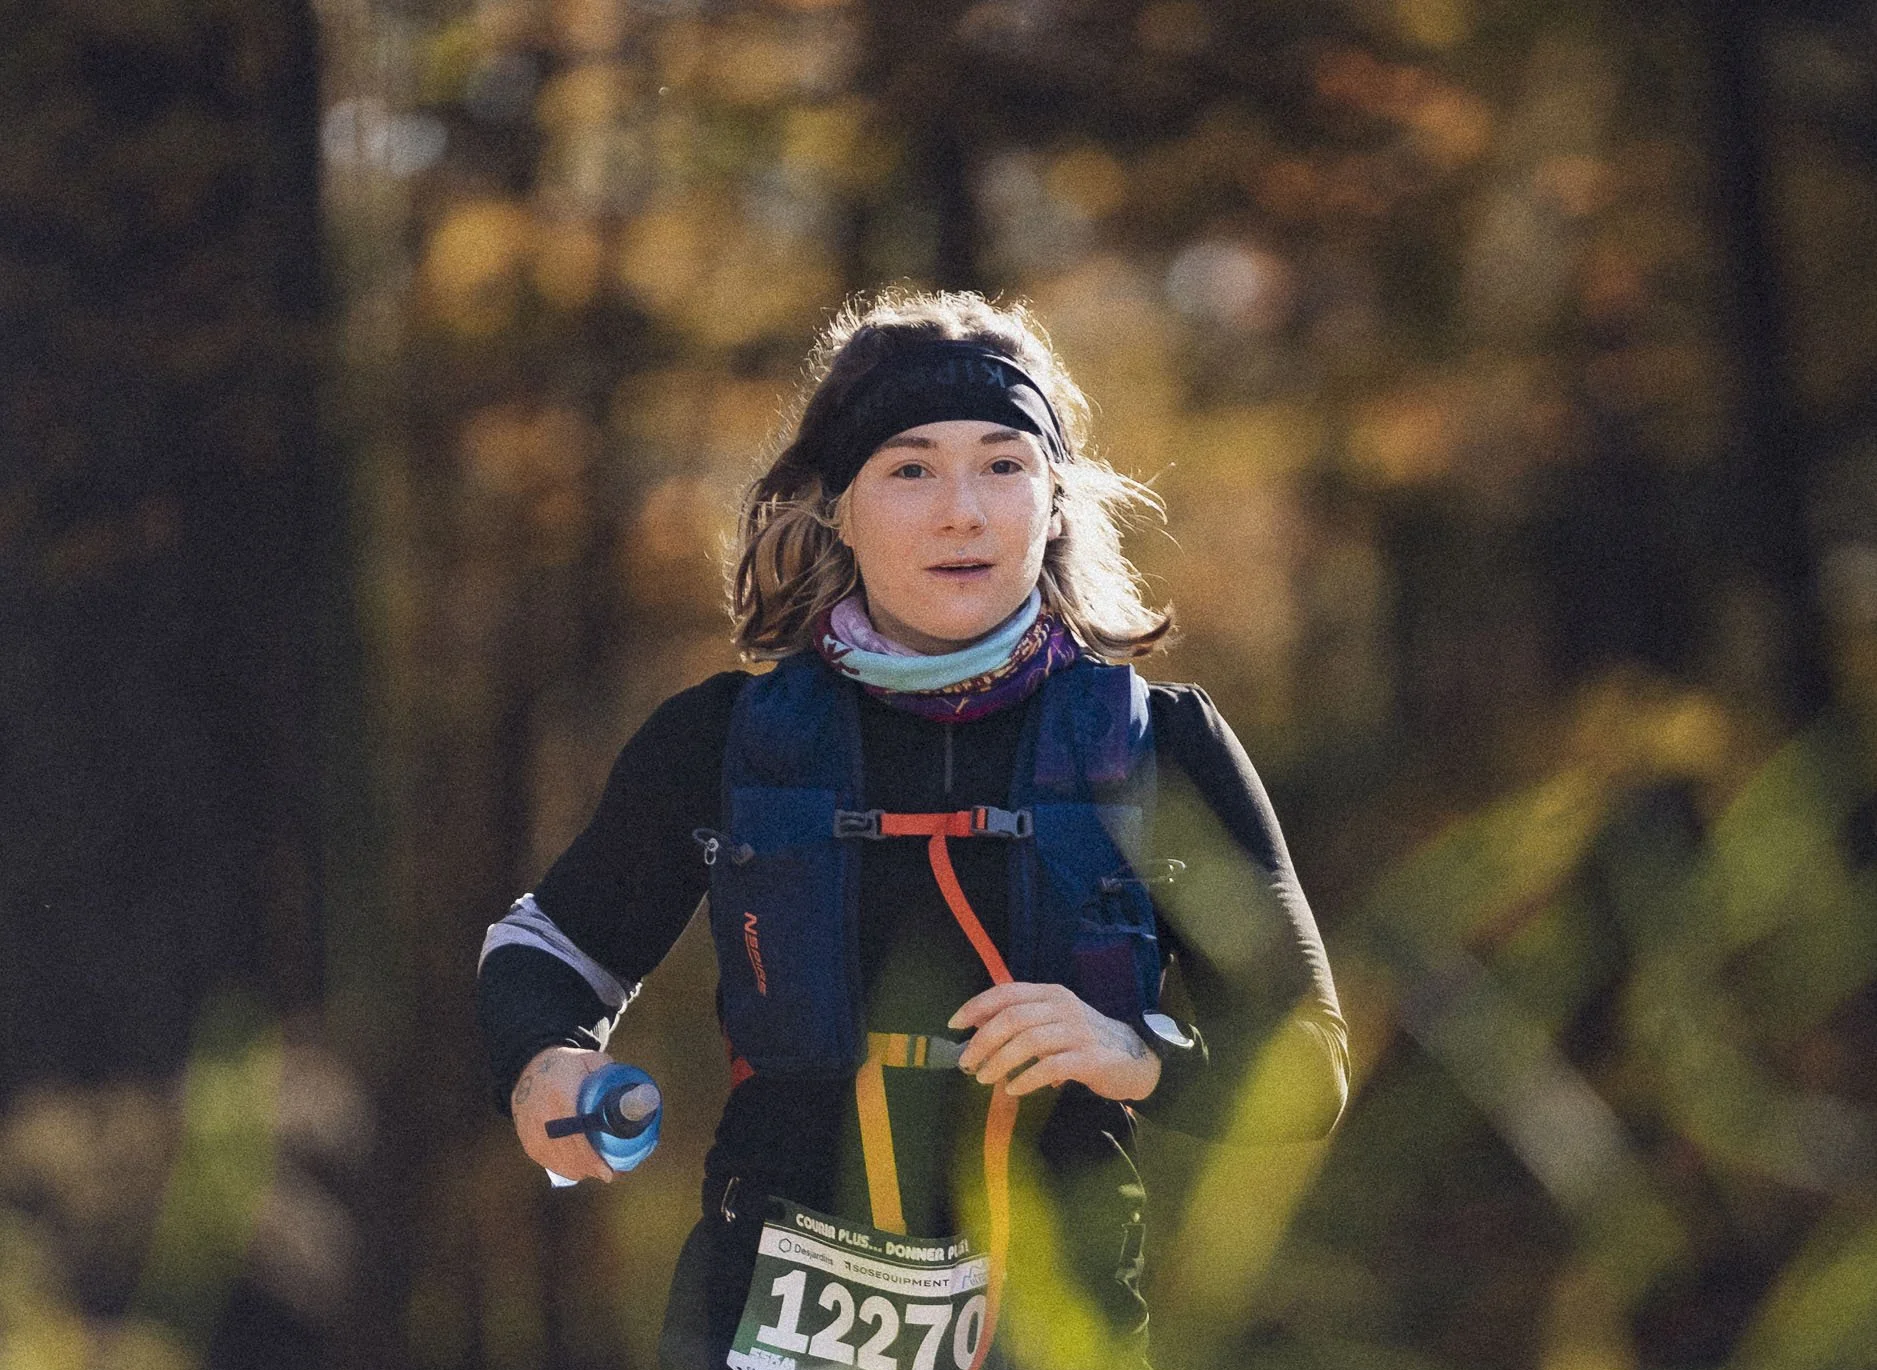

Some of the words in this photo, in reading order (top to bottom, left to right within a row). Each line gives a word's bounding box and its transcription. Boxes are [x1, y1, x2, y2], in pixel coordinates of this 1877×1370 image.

[794, 1243, 834, 1267] Desjardins
[795, 1213, 836, 1241] COURIR
[885, 1241, 945, 1262] DONNER
